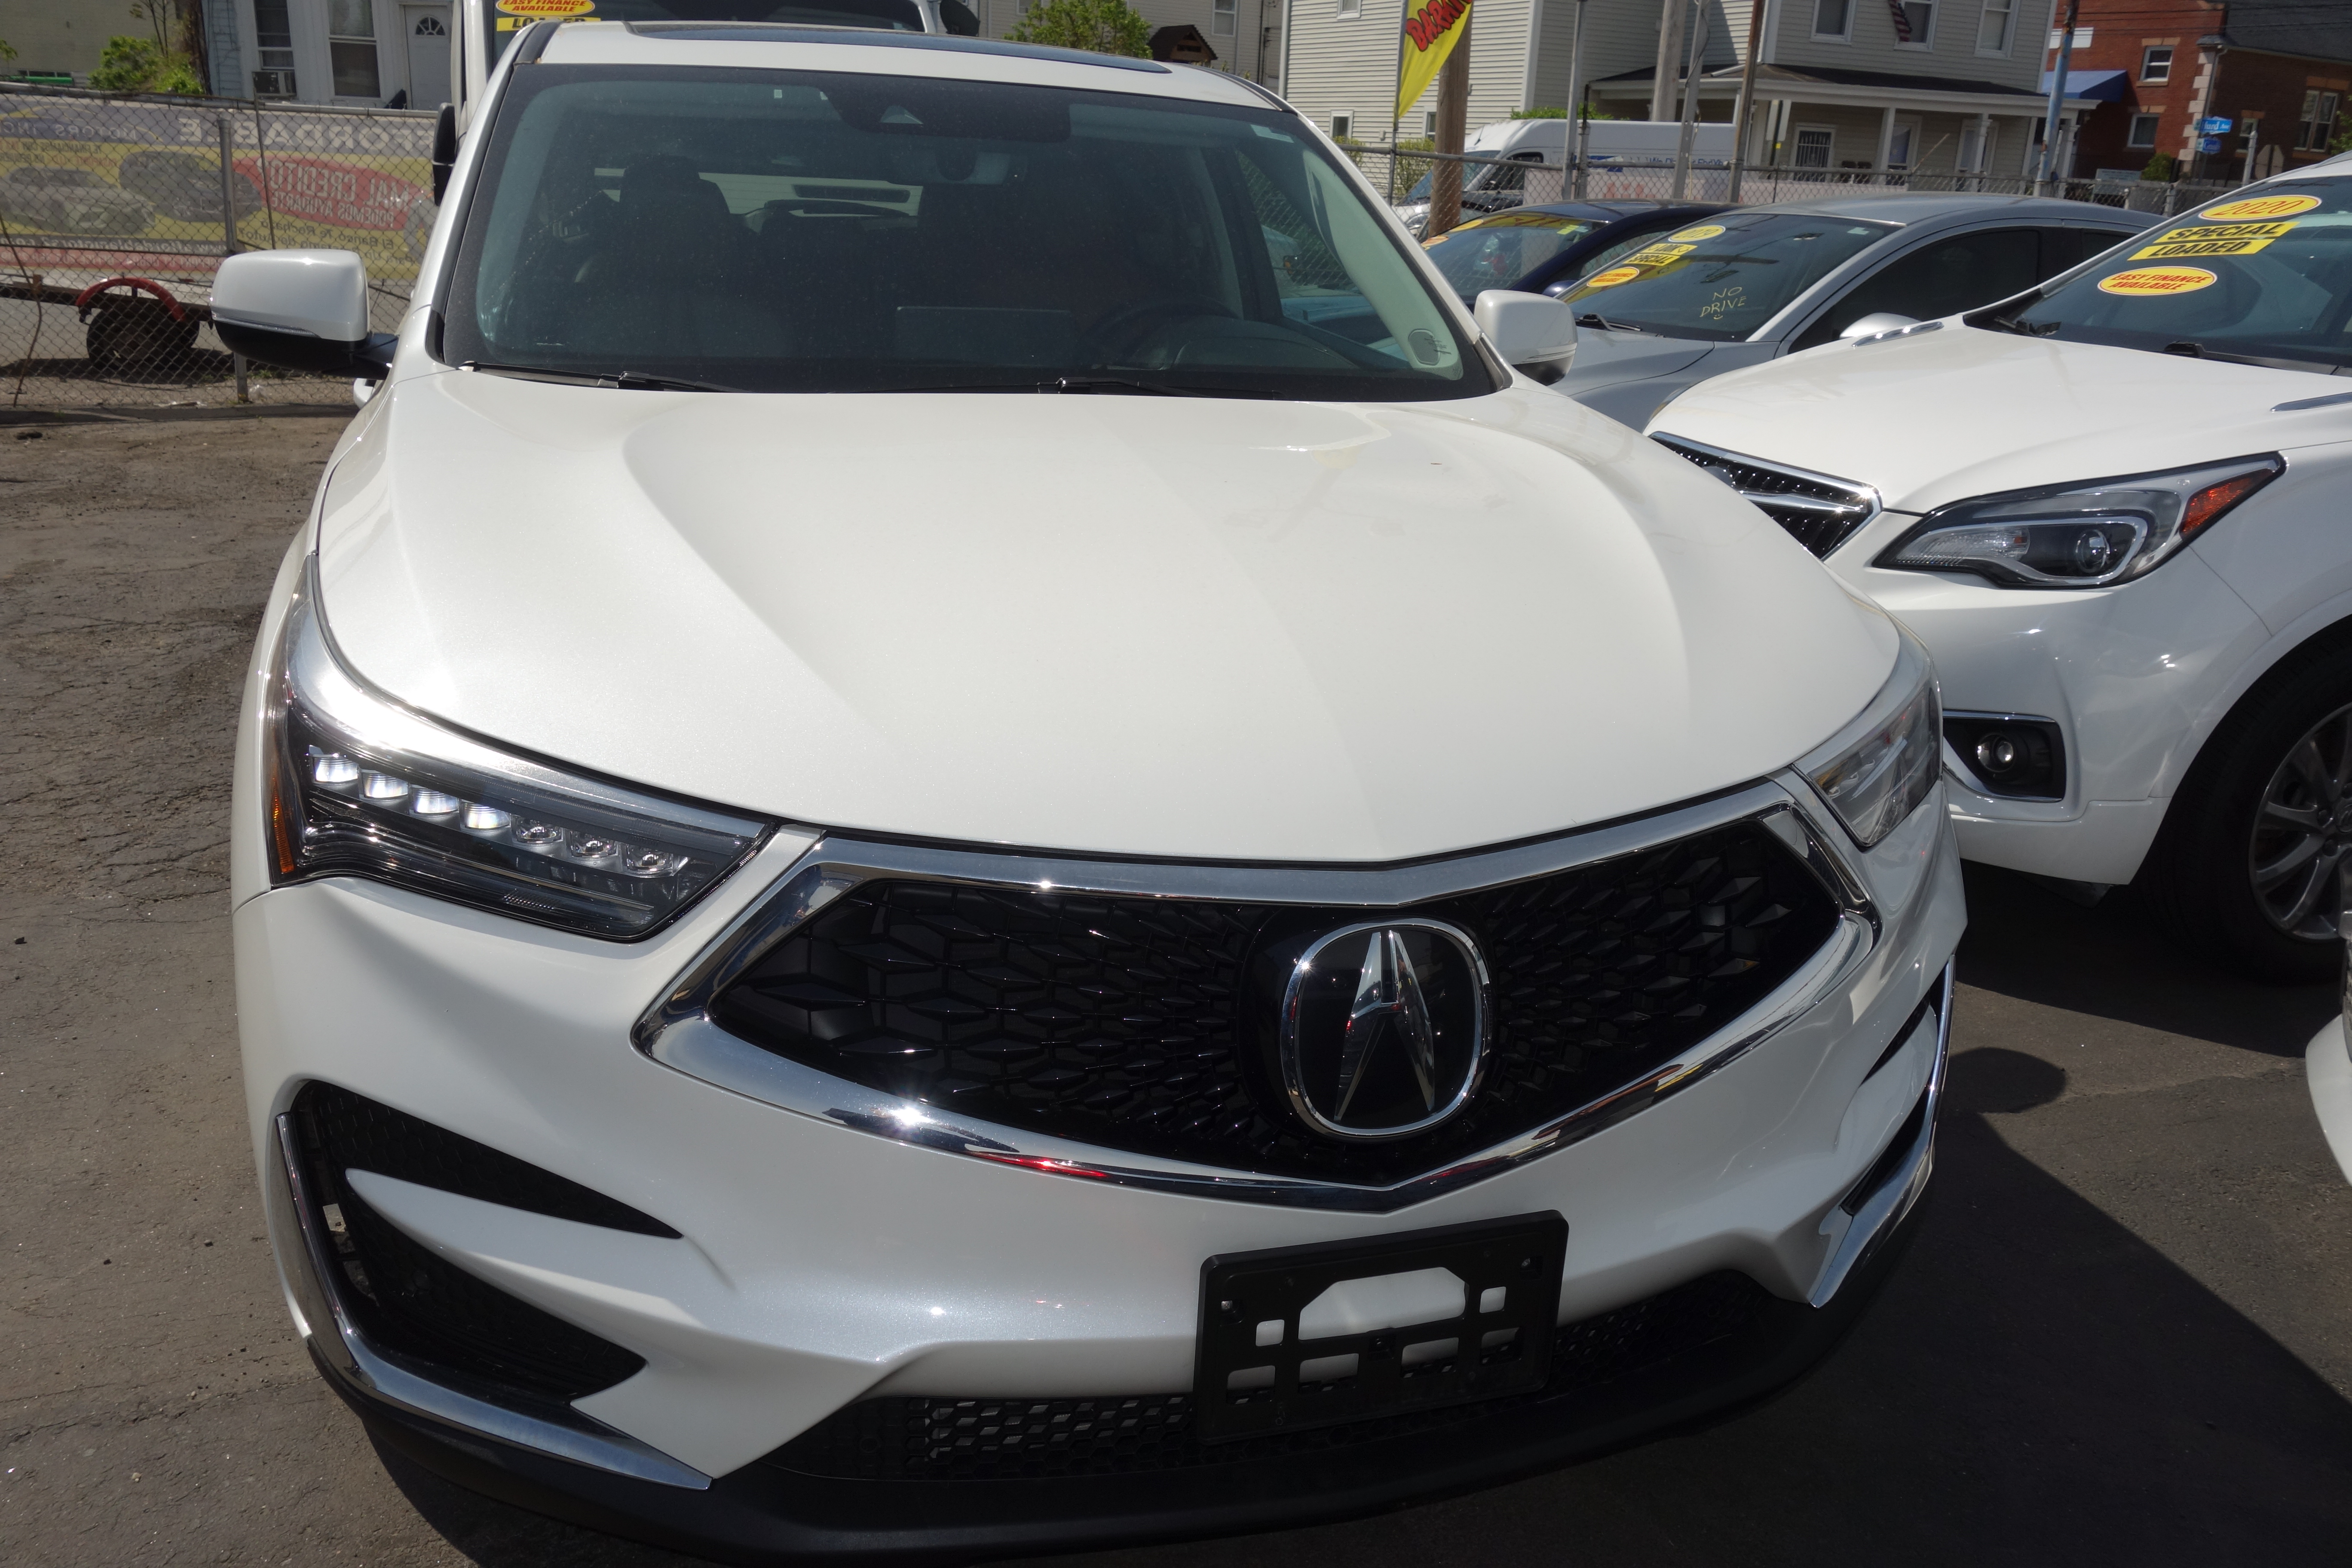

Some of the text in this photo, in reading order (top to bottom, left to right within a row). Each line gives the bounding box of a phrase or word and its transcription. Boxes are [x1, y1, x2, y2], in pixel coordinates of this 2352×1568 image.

[2210, 199, 2305, 216] 2020
[2168, 224, 2285, 240] SPECIAL
[2149, 240, 2251, 257] LOADED
[2109, 281, 2186, 290] AVAILABLE
[2150, 274, 2211, 284] FINANCE
[1712, 287, 1743, 300] NO
[1699, 295, 1747, 318] DRIVE
